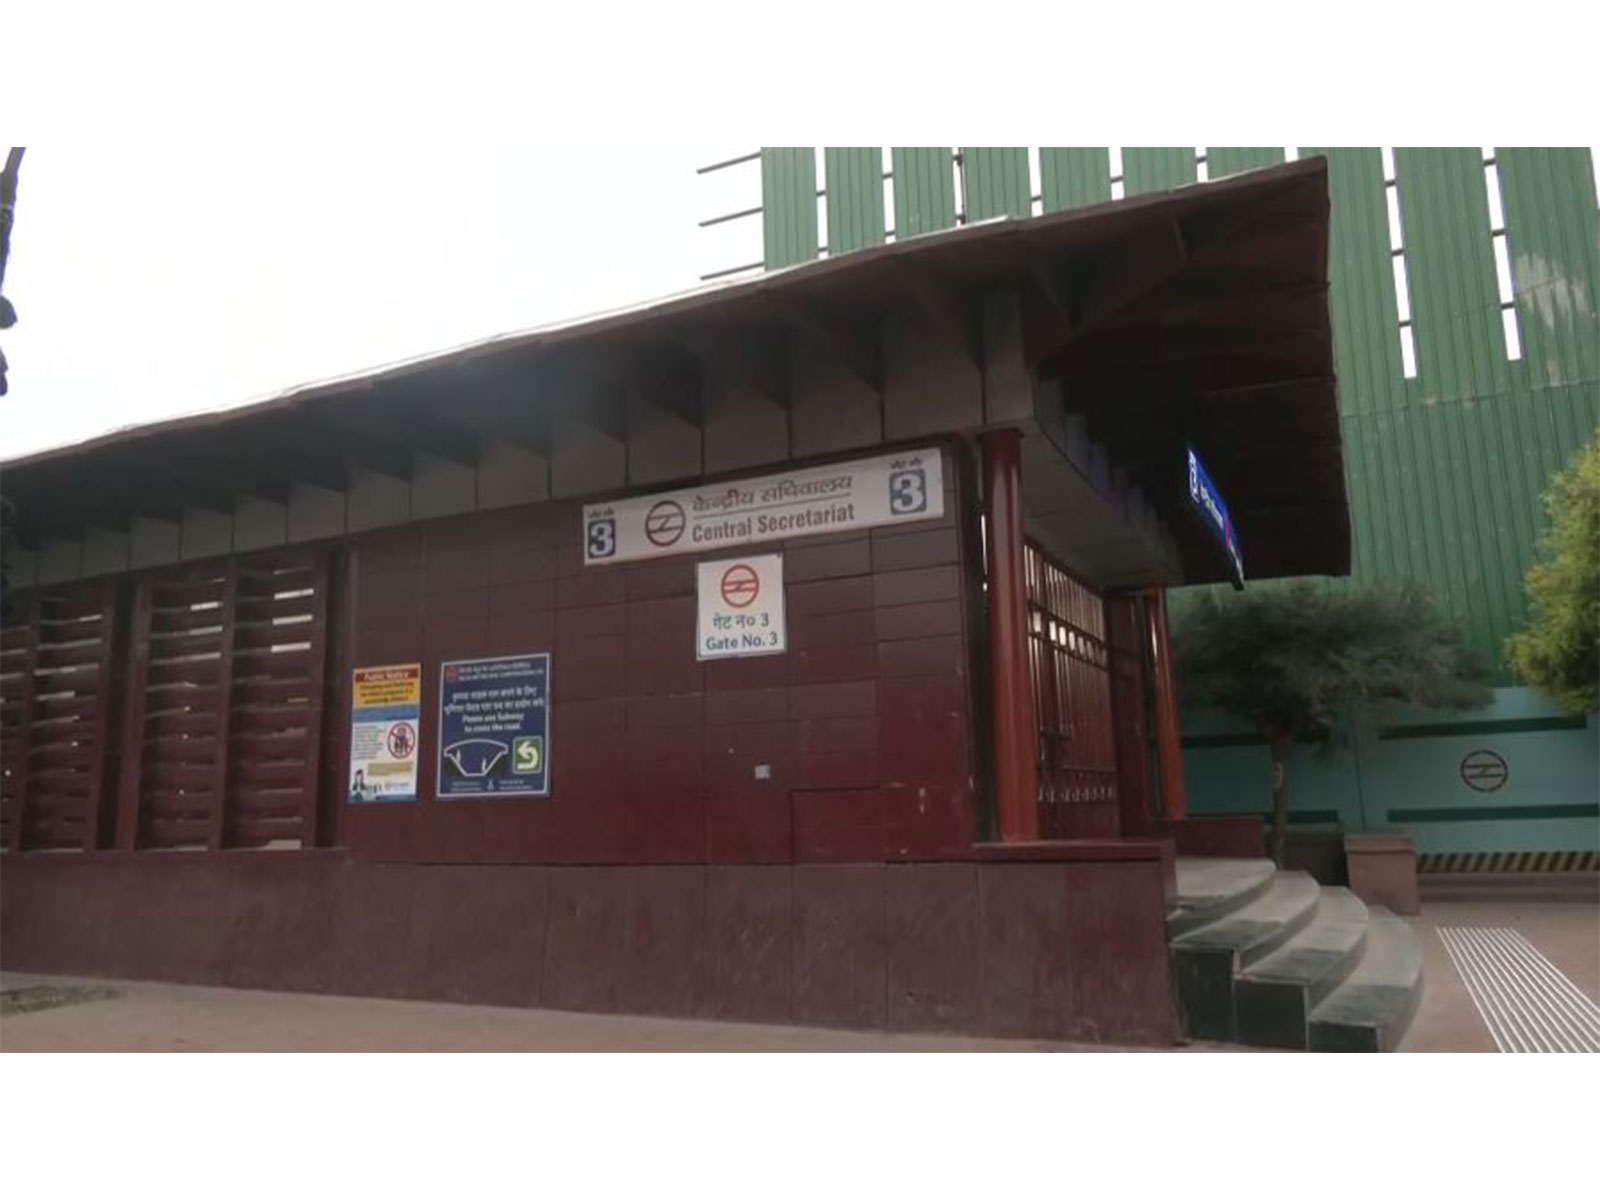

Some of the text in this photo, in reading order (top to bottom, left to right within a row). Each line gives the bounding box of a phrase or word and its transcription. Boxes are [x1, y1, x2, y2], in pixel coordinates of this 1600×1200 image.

[892, 473, 923, 513] 3
[589, 522, 614, 557] 3
[692, 502, 855, 543] Central Secretariat
[760, 612, 770, 628] 3
[706, 631, 778, 651] Gate No. 3
